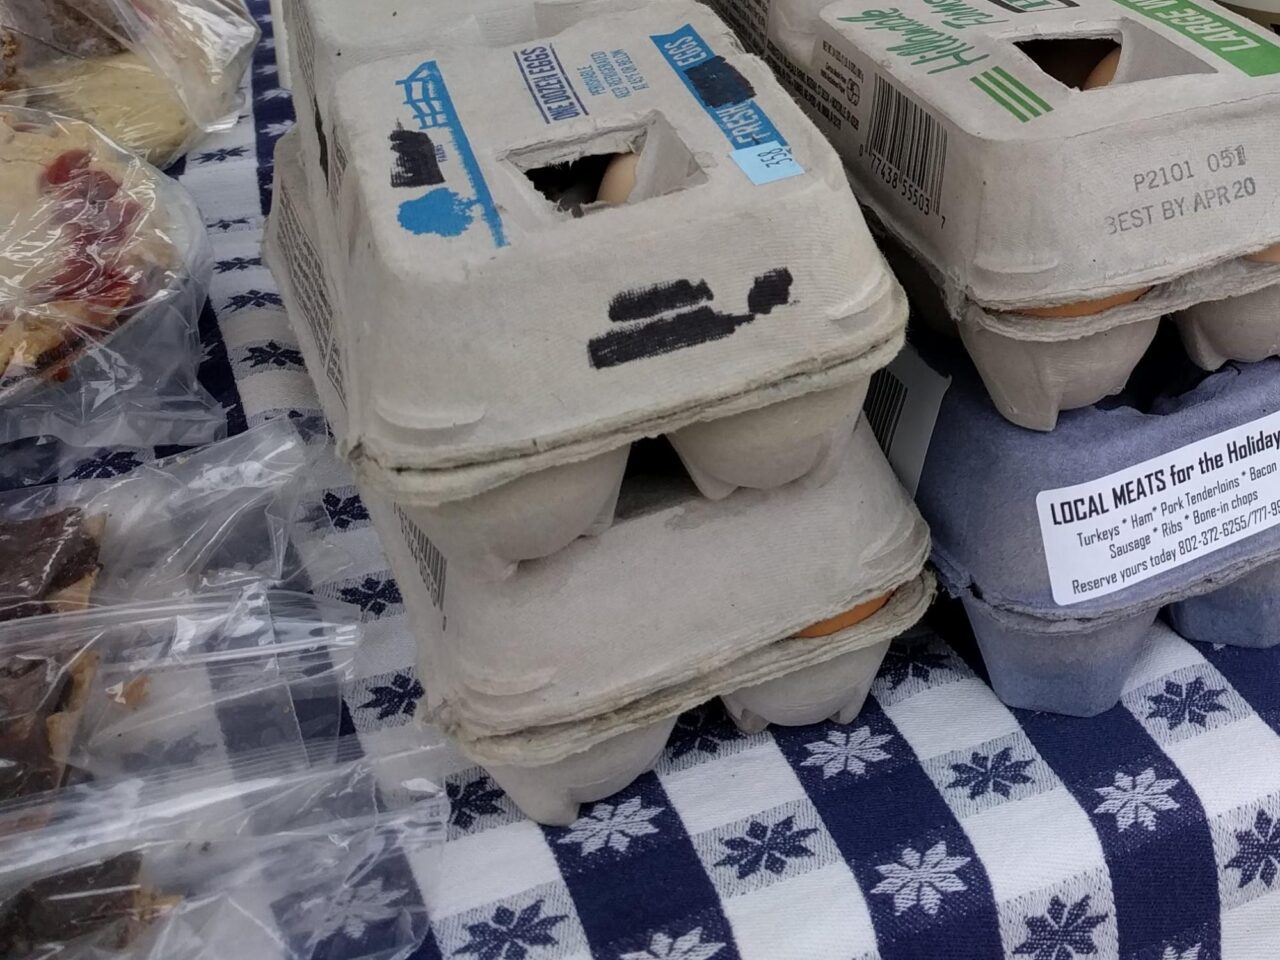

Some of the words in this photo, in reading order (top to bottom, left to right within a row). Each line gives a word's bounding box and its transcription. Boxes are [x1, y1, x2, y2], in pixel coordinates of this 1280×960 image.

[665, 33, 706, 66] EGGS
[1163, 1, 1259, 56] LARGE
[515, 42, 555, 78] EGGS
[530, 70, 571, 107] DOZEN
[547, 101, 580, 124] ONE
[716, 100, 769, 147] FRESH
[871, 153, 899, 190] 77438
[901, 177, 931, 216] 55503
[1133, 162, 1196, 193] P2101
[1162, 197, 1186, 222] BY
[1192, 187, 1229, 215] APR
[1051, 493, 1110, 526] LOCAL
[1112, 469, 1167, 509] MEATS
[1170, 463, 1195, 488] for
[1198, 451, 1225, 474] the
[1076, 523, 1121, 548] Turkeys
[1160, 498, 1184, 517] Pork
[1185, 475, 1241, 508] Tenderloins
[1249, 460, 1278, 481] Bacon
[1108, 533, 1152, 560] Sausage
[1162, 520, 1183, 538] Ribs
[1193, 501, 1230, 525] Bone-in
[1231, 488, 1259, 514] chops
[1071, 569, 1118, 595] Reserve
[1120, 558, 1149, 583] yours
[1150, 546, 1177, 573] today
